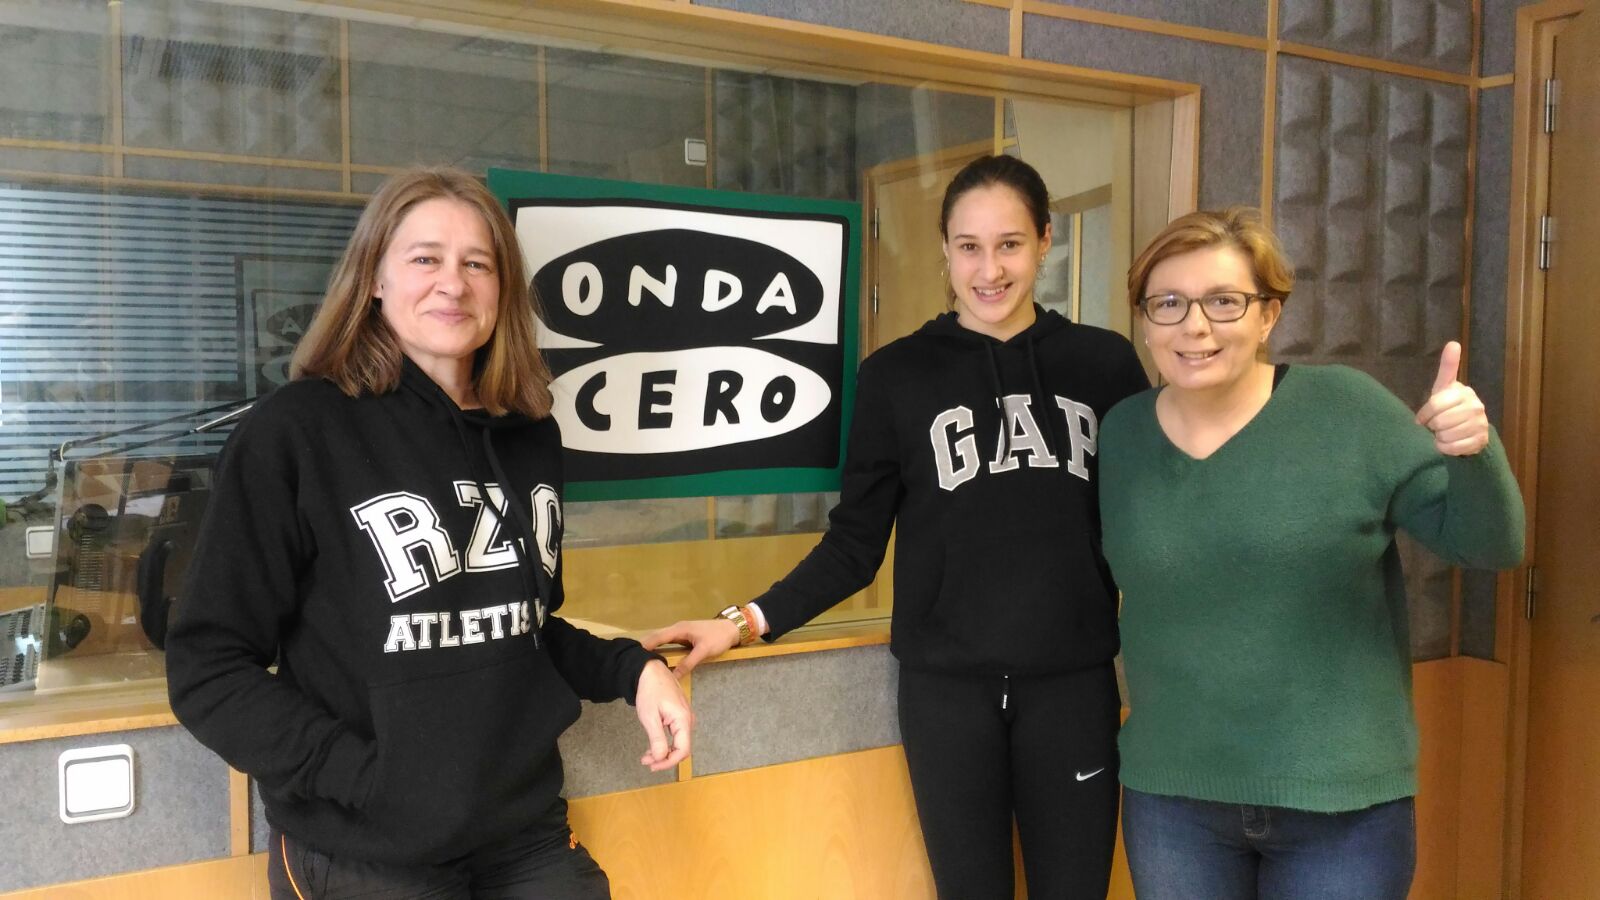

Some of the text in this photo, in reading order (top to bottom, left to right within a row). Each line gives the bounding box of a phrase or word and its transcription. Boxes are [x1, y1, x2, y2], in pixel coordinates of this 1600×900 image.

[562, 261, 797, 316] ONDA
[575, 369, 796, 431] CERO
[930, 394, 1099, 491] GAP
